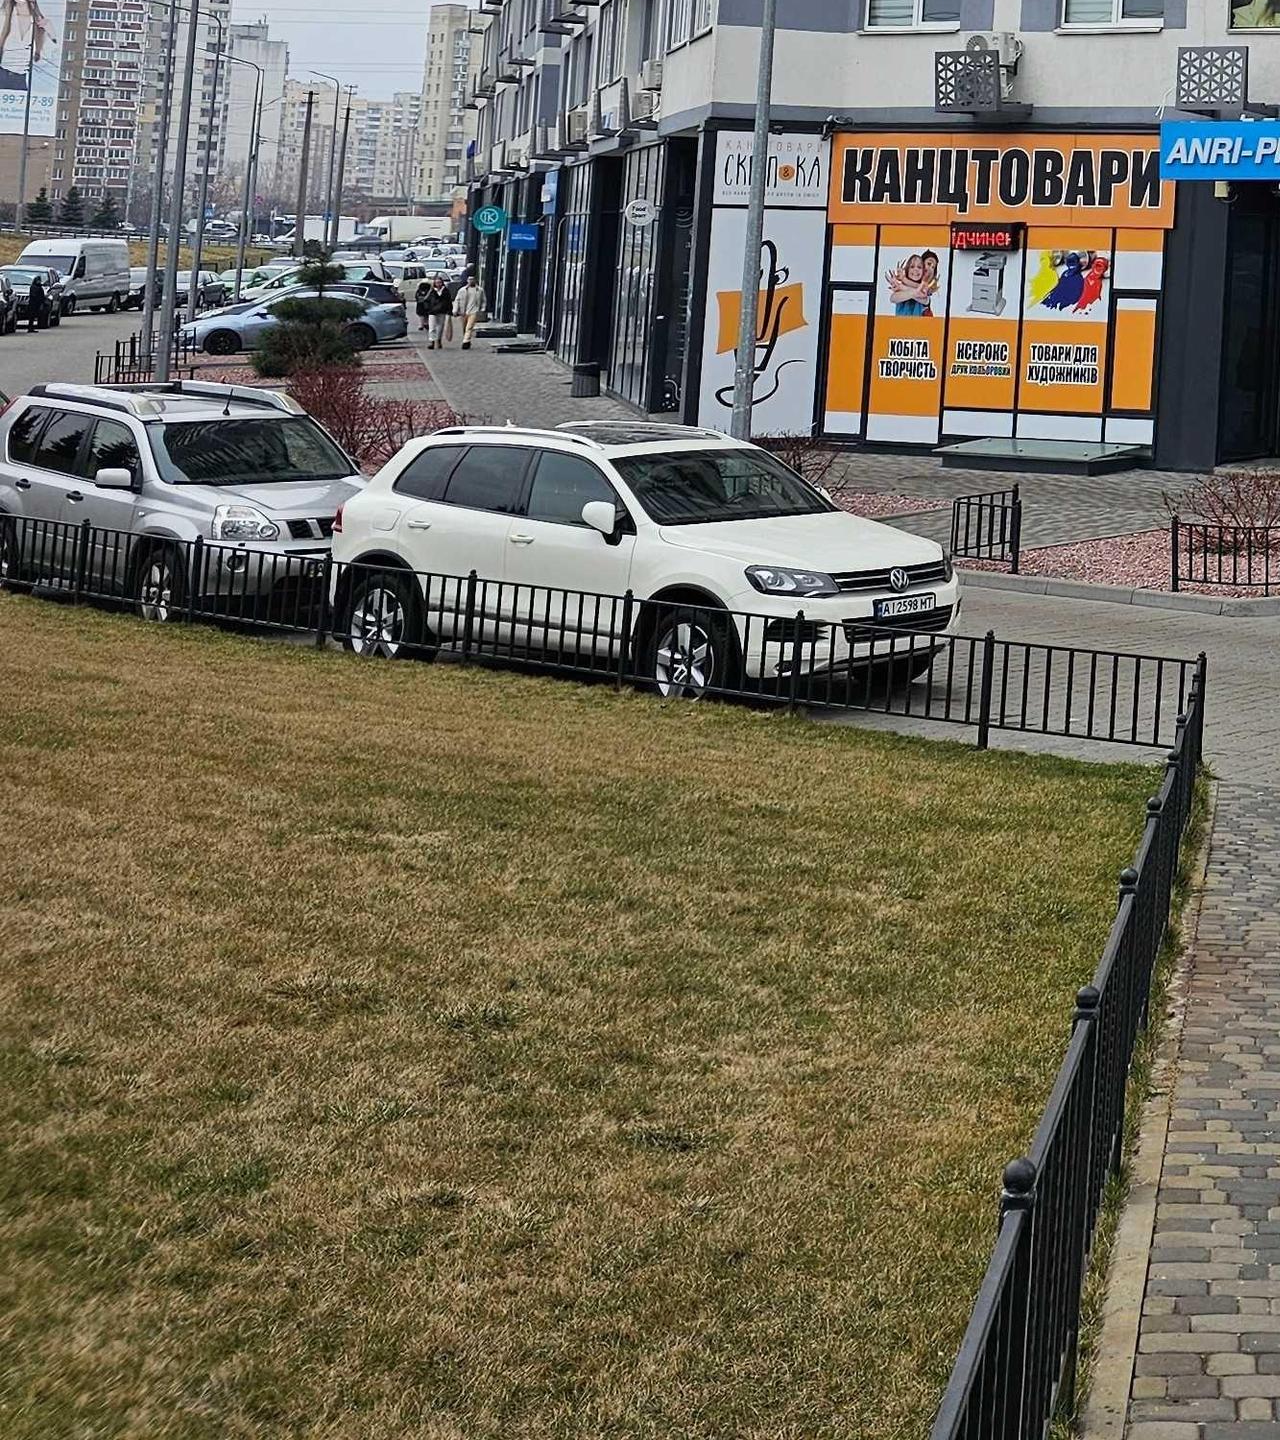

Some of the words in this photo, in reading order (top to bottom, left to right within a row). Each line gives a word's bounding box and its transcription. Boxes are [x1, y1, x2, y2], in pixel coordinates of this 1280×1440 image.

[842, 148, 1161, 213] КАНЦТОВАРИ
[889, 340, 914, 357] ХОБІ
[915, 342, 928, 358] ТА
[956, 343, 1008, 360] КСЕРОКС
[1031, 344, 1073, 362] ТОВАРИ
[1074, 346, 1098, 364] ДЛЯ
[880, 361, 936, 379] ТВОРЧІСТЬ
[1027, 364, 1099, 384] ХУДОЖНИКІВ
[897, 599, 919, 613] 2598
